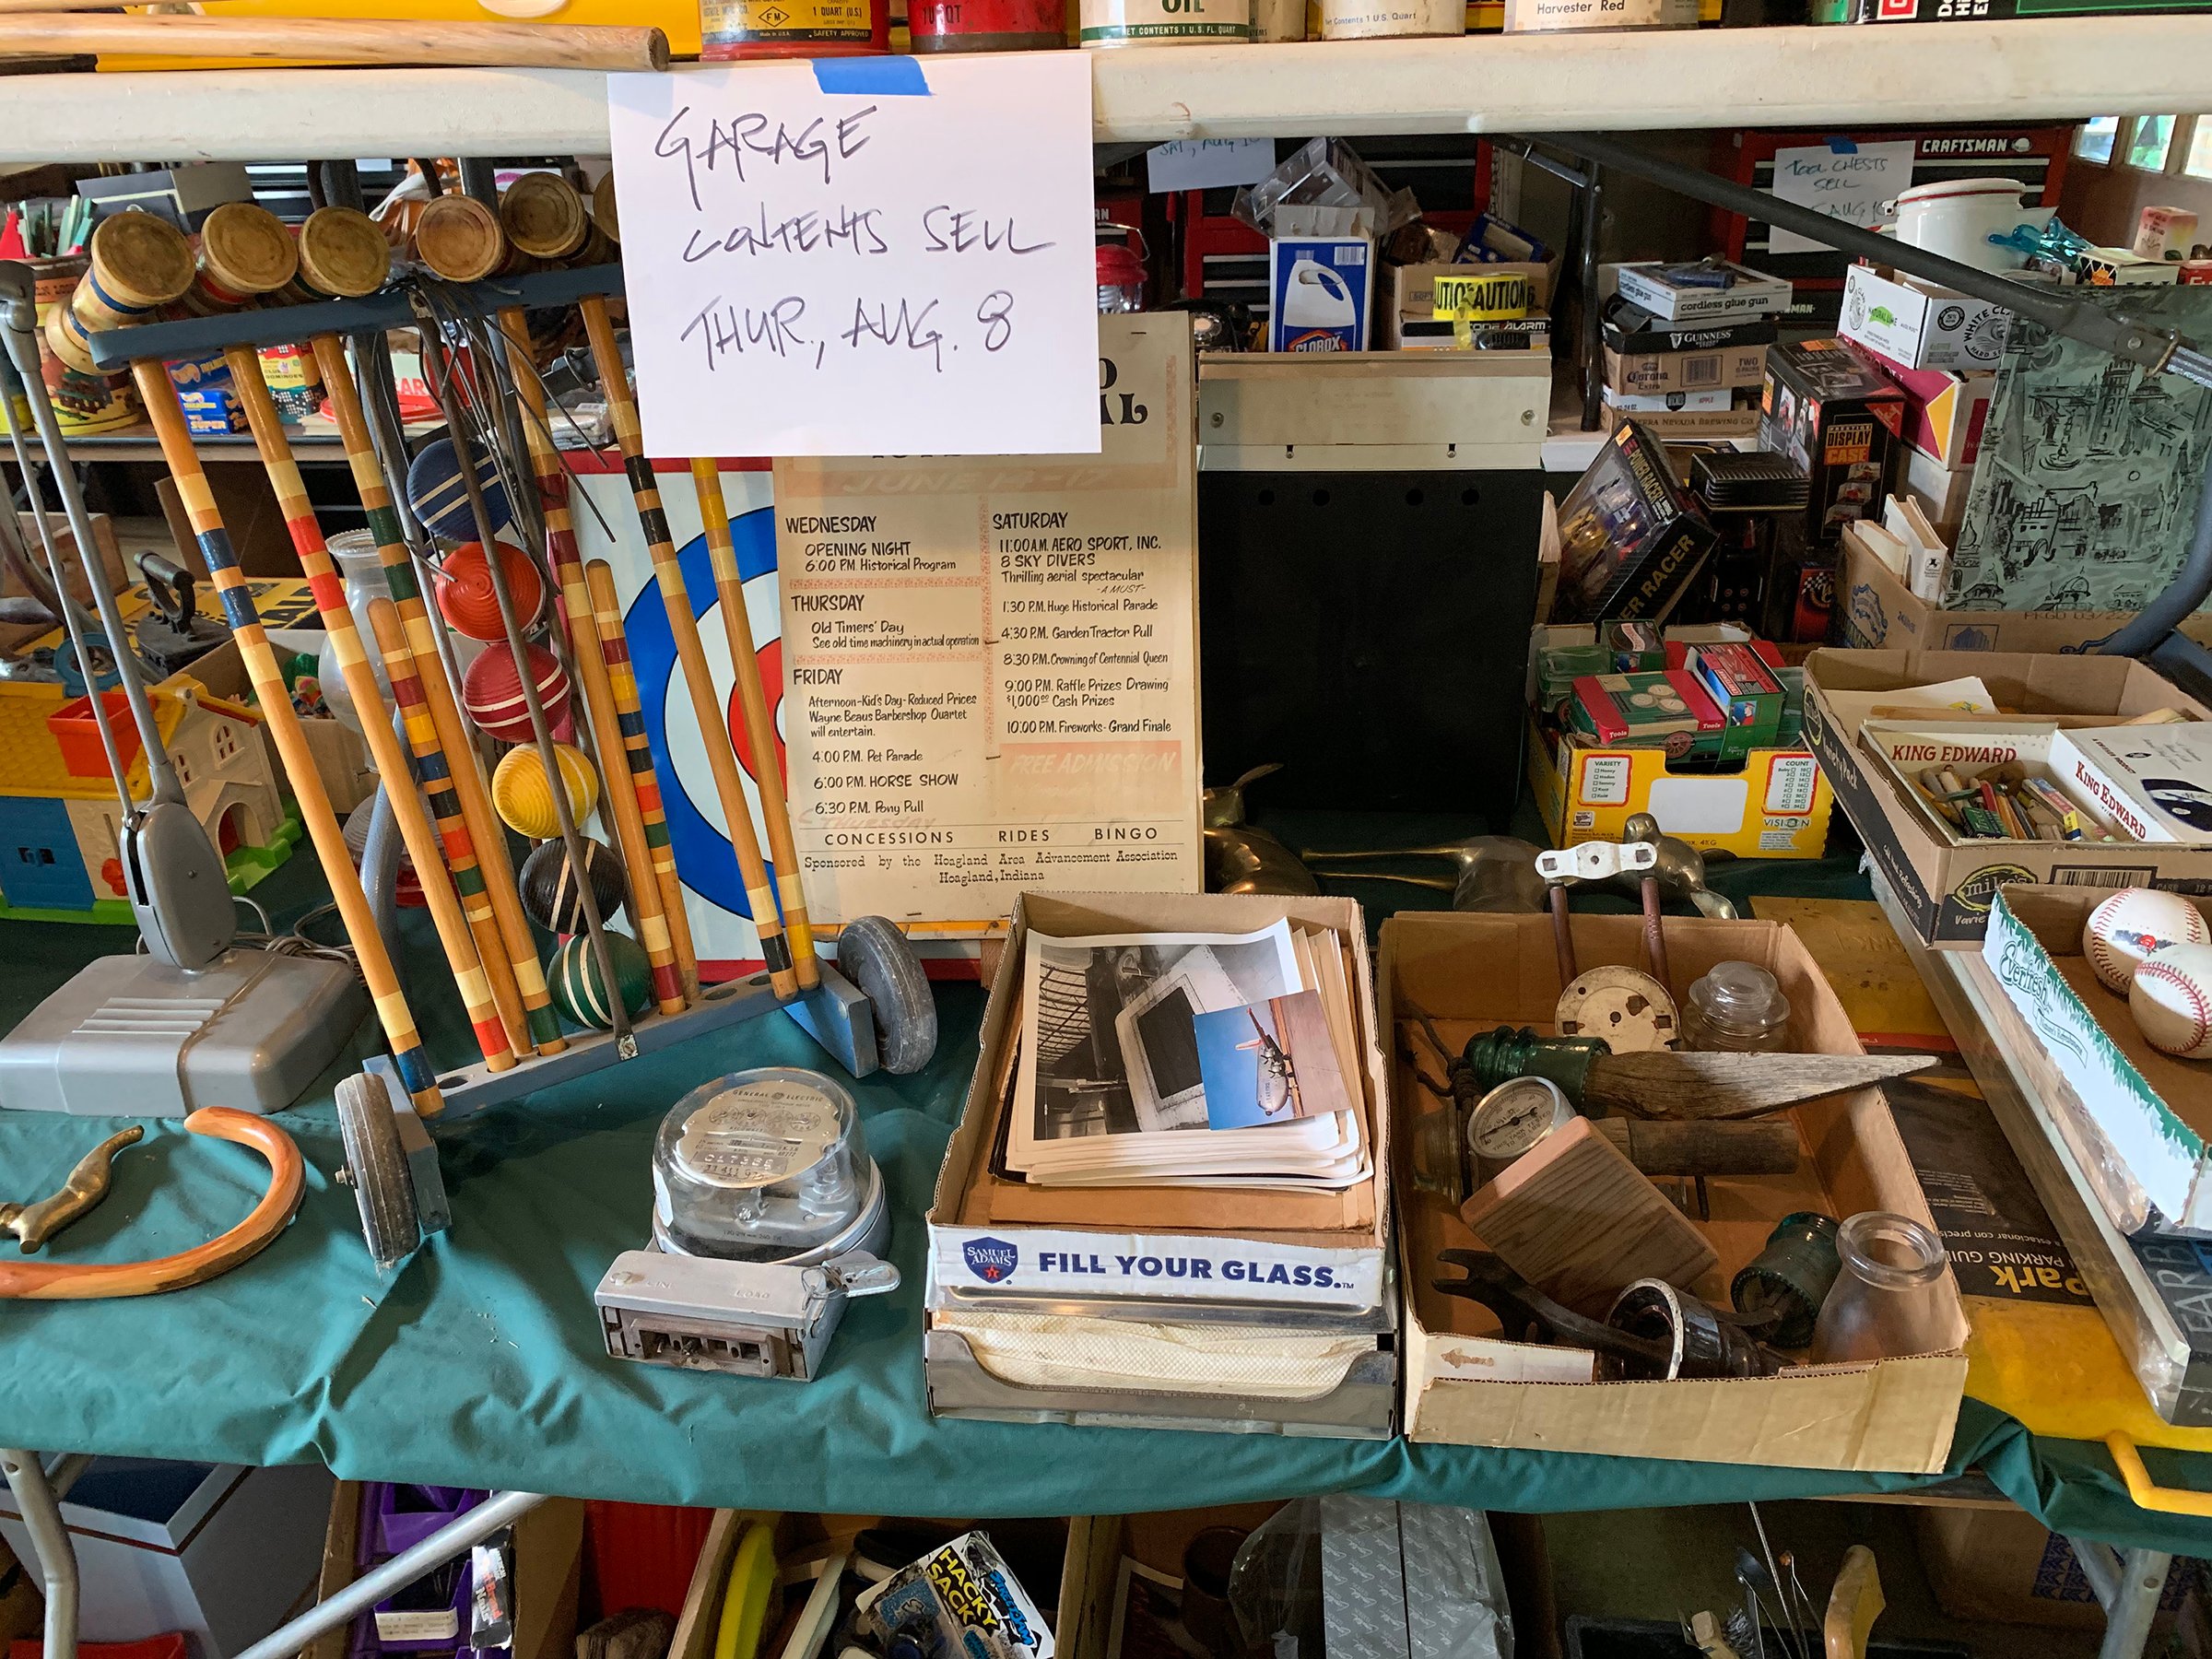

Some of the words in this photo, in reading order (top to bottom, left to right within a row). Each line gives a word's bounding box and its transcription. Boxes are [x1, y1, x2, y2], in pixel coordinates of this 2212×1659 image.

[813, 7, 817, 17] 1
[820, 6, 842, 17] QUART
[846, 6, 863, 18] (U.S.)
[1536, 2, 1593, 17] Harvester
[1601, 0, 1625, 11] Red
[1335, 15, 1363, 25] Contents
[1366, 14, 1370, 23] 1
[1373, 14, 1389, 22] U.S.
[1392, 12, 1418, 21] Quart
[813, 29, 838, 38] SAFETY
[841, 29, 869, 38] APPROVED
[1138, 24, 1179, 36] CONTENTS
[1182, 24, 1185, 34] 1
[1189, 24, 1205, 35] U.S.
[1206, 24, 1217, 34] FL.
[1218, 25, 1236, 34] QUART
[1922, 138, 2007, 153] CRAFTSMAN
[655, 105, 877, 211] GARAGE
[1831, 157, 1888, 172] CHESTS
[1814, 177, 1860, 192] SELL
[682, 202, 888, 264] CONTENTS
[924, 205, 1057, 255] SELL
[1680, 300, 1723, 312] cordless
[1724, 298, 1747, 309] glue
[1747, 296, 1769, 307] gun
[841, 297, 959, 373] AUG.
[977, 289, 1014, 353] 8
[1963, 308, 1990, 343] WHITE
[1684, 330, 1731, 343] GUINNESS
[1738, 358, 1759, 367] TWO
[1627, 371, 1668, 383] Corona
[1638, 381, 1661, 390] Extra
[1663, 418, 1696, 426] NEVADA
[1699, 417, 1738, 425] BREWING
[1827, 429, 1871, 447] DISPLAY
[1826, 448, 1867, 464] CASE
[1627, 449, 1648, 478] POWER
[1641, 471, 1663, 507] RACER
[785, 516, 877, 534] WEDNESDAY
[992, 512, 1068, 531] SATURDAY
[805, 542, 867, 557] OPENING
[871, 541, 912, 556] NIGHT
[999, 537, 1030, 553] 11:00
[1052, 536, 1083, 552] AERO
[1087, 535, 1133, 552] SPORT,
[1136, 535, 1162, 550] INC.
[805, 559, 836, 572] 6:00
[860, 558, 911, 571] Historical
[912, 557, 957, 572] Program
[1000, 555, 1011, 568] 8
[1015, 554, 1042, 568] SKY
[1046, 553, 1096, 568] DIVERS
[1642, 534, 1696, 598] RACER
[1001, 570, 1044, 585] Thrilling
[1046, 569, 1077, 582] aerial
[1081, 568, 1145, 585] spectacular
[790, 594, 865, 612] THURSDAY
[1002, 600, 1026, 614] 1:30
[1029, 600, 1046, 614] P.M.
[1047, 602, 1070, 616] Huge
[1072, 599, 1119, 613] Historical
[1123, 598, 1159, 611] Parade
[811, 621, 832, 634] Old
[835, 620, 877, 633] Timers'
[880, 619, 904, 635] Day
[1001, 626, 1028, 640] 4:30
[1030, 626, 1049, 640] P.M.
[1052, 625, 1089, 640] Garden
[1088, 625, 1130, 639] Tractor
[1133, 624, 1153, 638] Pull
[812, 636, 831, 649] See
[832, 636, 847, 649] old
[849, 635, 869, 649] time
[870, 635, 912, 651] machinery
[912, 635, 923, 647] in
[923, 634, 945, 647] actual
[945, 633, 980, 650] operation
[1003, 653, 1030, 666] 8:30
[1050, 653, 1088, 667] Crowning
[1088, 653, 1098, 665] of
[1099, 652, 1140, 665] Centennial
[1143, 651, 1169, 666] Queen
[793, 668, 843, 685] FRIDAY
[1005, 678, 1032, 693] 9:00
[1035, 678, 1053, 692] P.M.
[1056, 678, 1086, 692] Raffle
[1088, 677, 1122, 691] Prizes
[1125, 677, 1169, 692] Drawing
[947, 692, 977, 705] Prices
[1052, 694, 1077, 707] Cash
[1081, 693, 1115, 707] Prizes
[809, 710, 842, 725] Wayne
[844, 710, 874, 723] Beaus
[875, 709, 927, 724] Barbershop
[931, 708, 968, 721] Quartet
[810, 725, 826, 737] will
[828, 724, 876, 737] entertain.
[1006, 720, 1037, 734] 10:00
[1039, 720, 1057, 734] P.M.
[1108, 719, 1140, 733] Grand
[1142, 718, 1171, 733] Finale
[1609, 729, 1628, 738] Tools
[812, 749, 841, 763] 4:00
[842, 749, 864, 763] P.M.
[867, 748, 883, 762] Pet
[886, 748, 924, 762] Parade
[1892, 745, 1936, 762] KING
[1941, 746, 2018, 763] EDWARD
[1009, 752, 1057, 774] FREE
[1057, 751, 1178, 774] ADMISSION
[814, 776, 843, 790] 6:00
[846, 775, 866, 789] P.M.
[869, 774, 912, 788] HORSE
[919, 773, 959, 786] SHOW
[815, 801, 846, 815] 6:30
[849, 801, 870, 814] P.M.
[875, 800, 900, 815] Pony
[904, 800, 924, 813] Pull
[2075, 760, 2100, 795] KING
[2100, 783, 2147, 840] EDWARD
[1763, 818, 1811, 828] VISION
[824, 830, 954, 846] CONCESSIONS
[998, 830, 1050, 842] RIDES
[1094, 827, 1158, 841] BINGO
[804, 855, 865, 872] Sponsored
[878, 854, 892, 869] by
[902, 854, 922, 867] the
[934, 853, 988, 868] Hoagland
[998, 853, 1025, 865] Area
[1035, 851, 1111, 865] Advancement
[1116, 850, 1178, 863] Association
[938, 870, 999, 888] Hoagland,
[1000, 868, 1044, 881] Indiana
[1999, 940, 2049, 1006] Everfresh
[732, 1089, 769, 1099] GENERAL
[786, 1094, 823, 1103] ELECTRIC
[1973, 1230, 1994, 1241] con
[1997, 1231, 2057, 1247] estacionar
[966, 1246, 1017, 1262] SAMUEL
[970, 1254, 1013, 1267] ADAMS
[1989, 1251, 2065, 1267] PARKING
[1039, 1252, 1106, 1275] FILL
[1114, 1255, 1212, 1279] YOUR
[1995, 1265, 2092, 1296] Park
[735, 1289, 771, 1300] LOAD
[925, 1562, 977, 1625] SACK
[938, 1547, 997, 1628] HACKY
